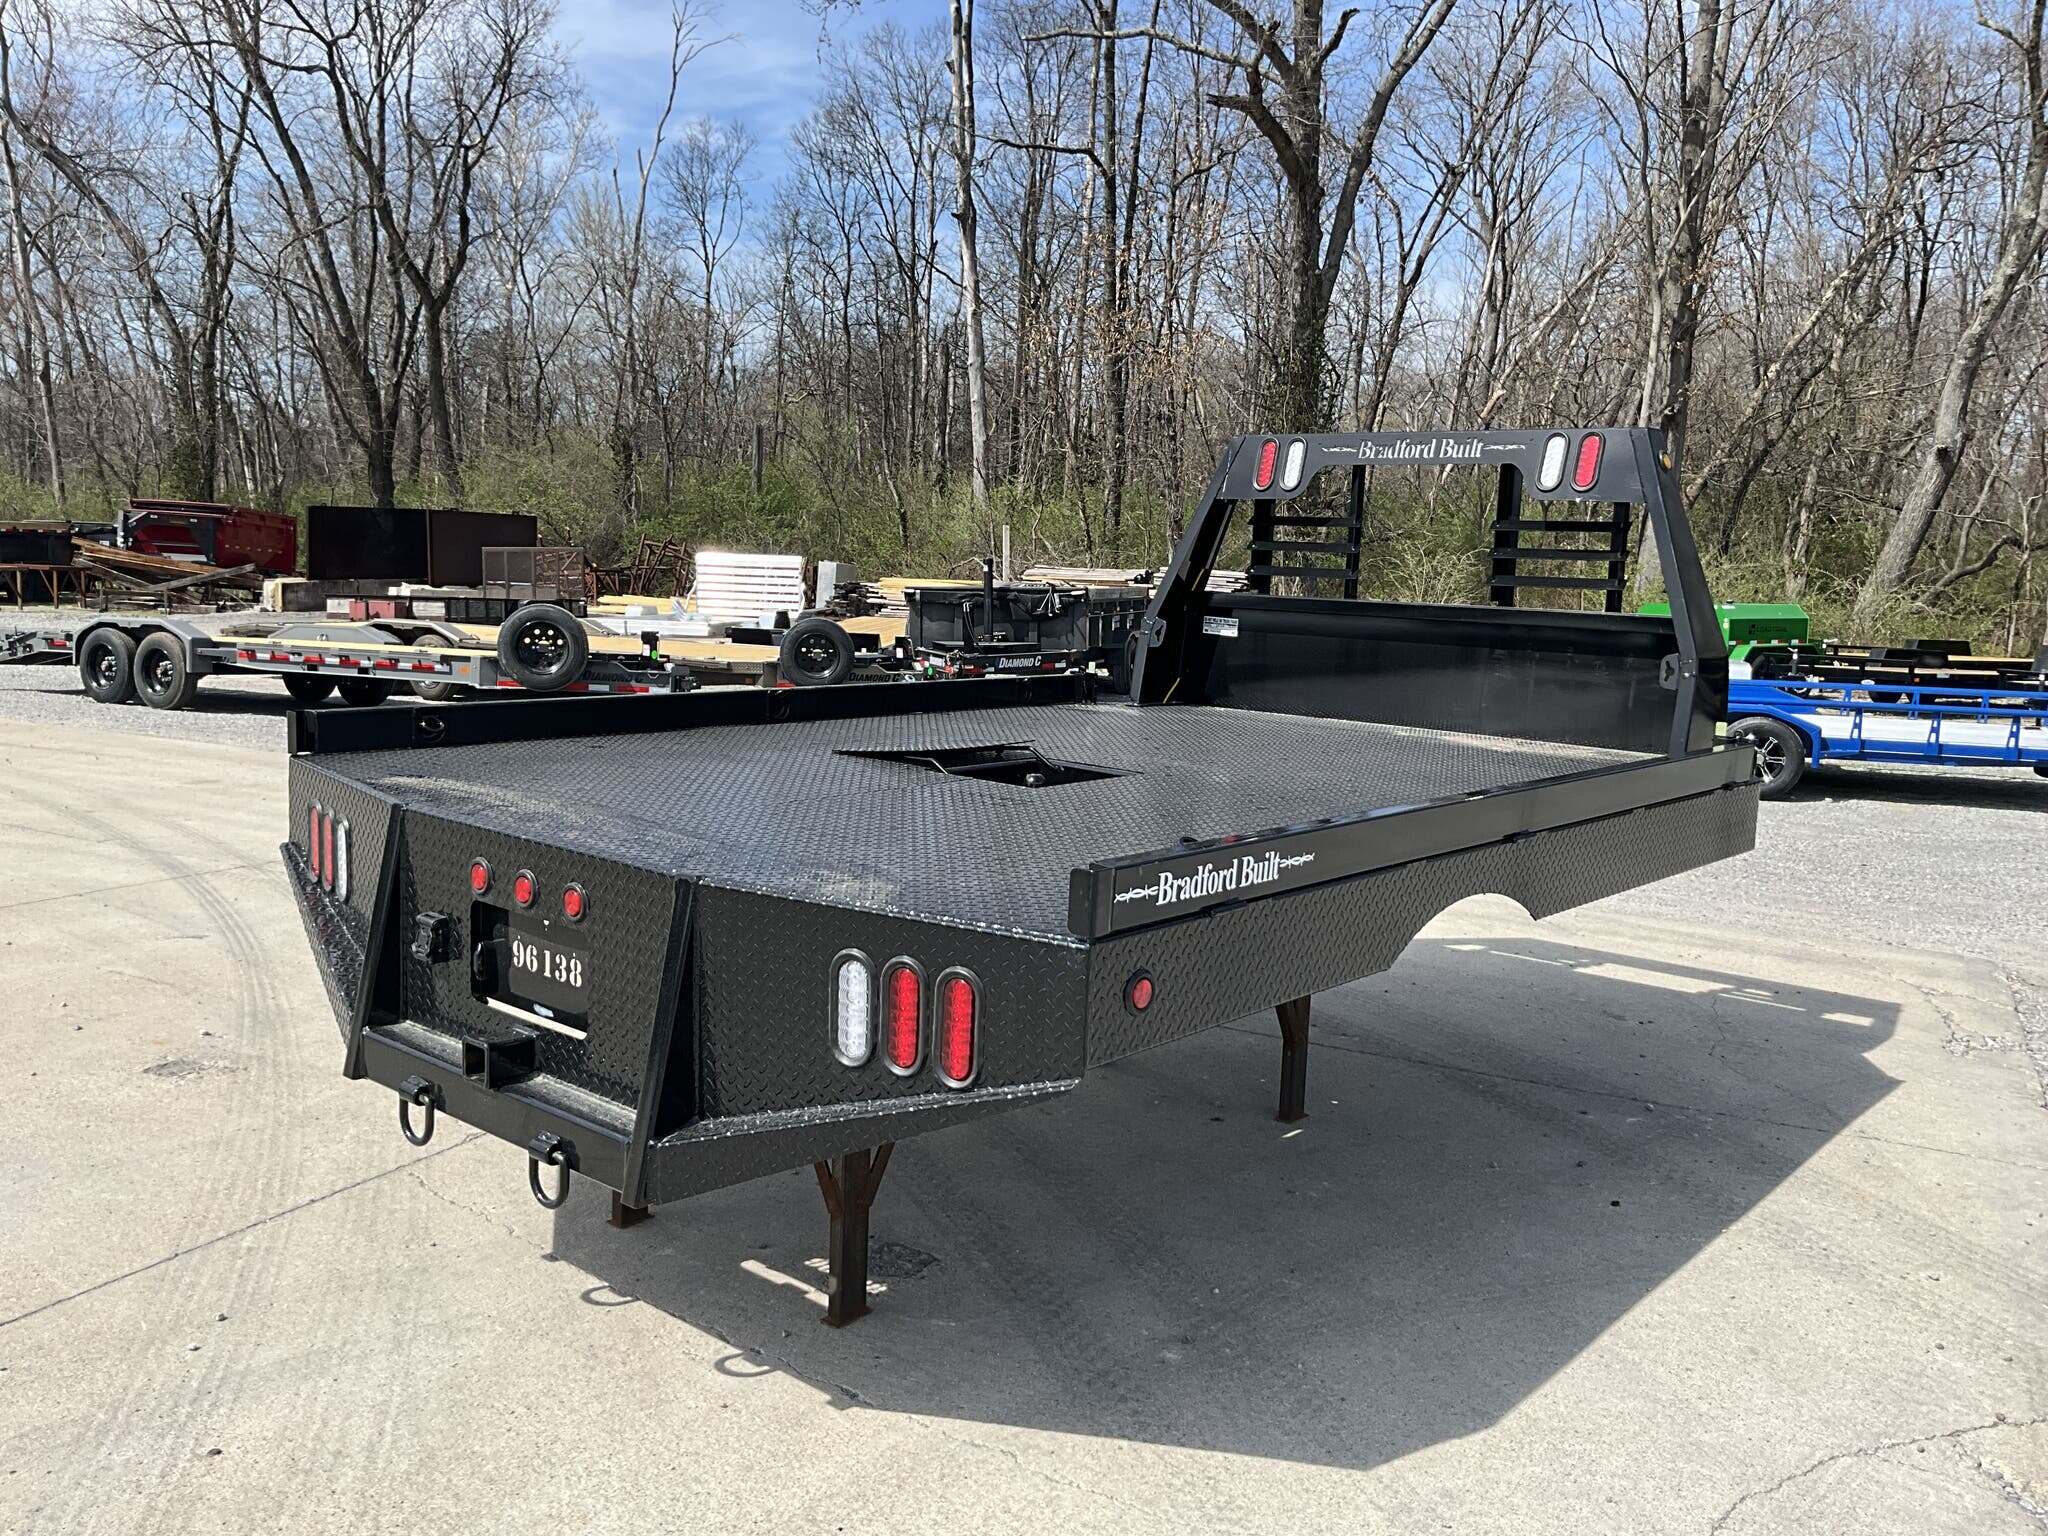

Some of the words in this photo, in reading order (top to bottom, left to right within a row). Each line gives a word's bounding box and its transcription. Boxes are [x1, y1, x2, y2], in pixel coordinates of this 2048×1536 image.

[1358, 438, 1437, 459] Bradford
[1439, 438, 1484, 459] Built
[999, 657, 1034, 668] DIAMOND
[1035, 655, 1041, 667] C
[848, 672, 890, 682] DIAMOND
[1156, 858, 1238, 906] Bradford
[1239, 850, 1280, 888] Built
[512, 939, 582, 988] 96138
